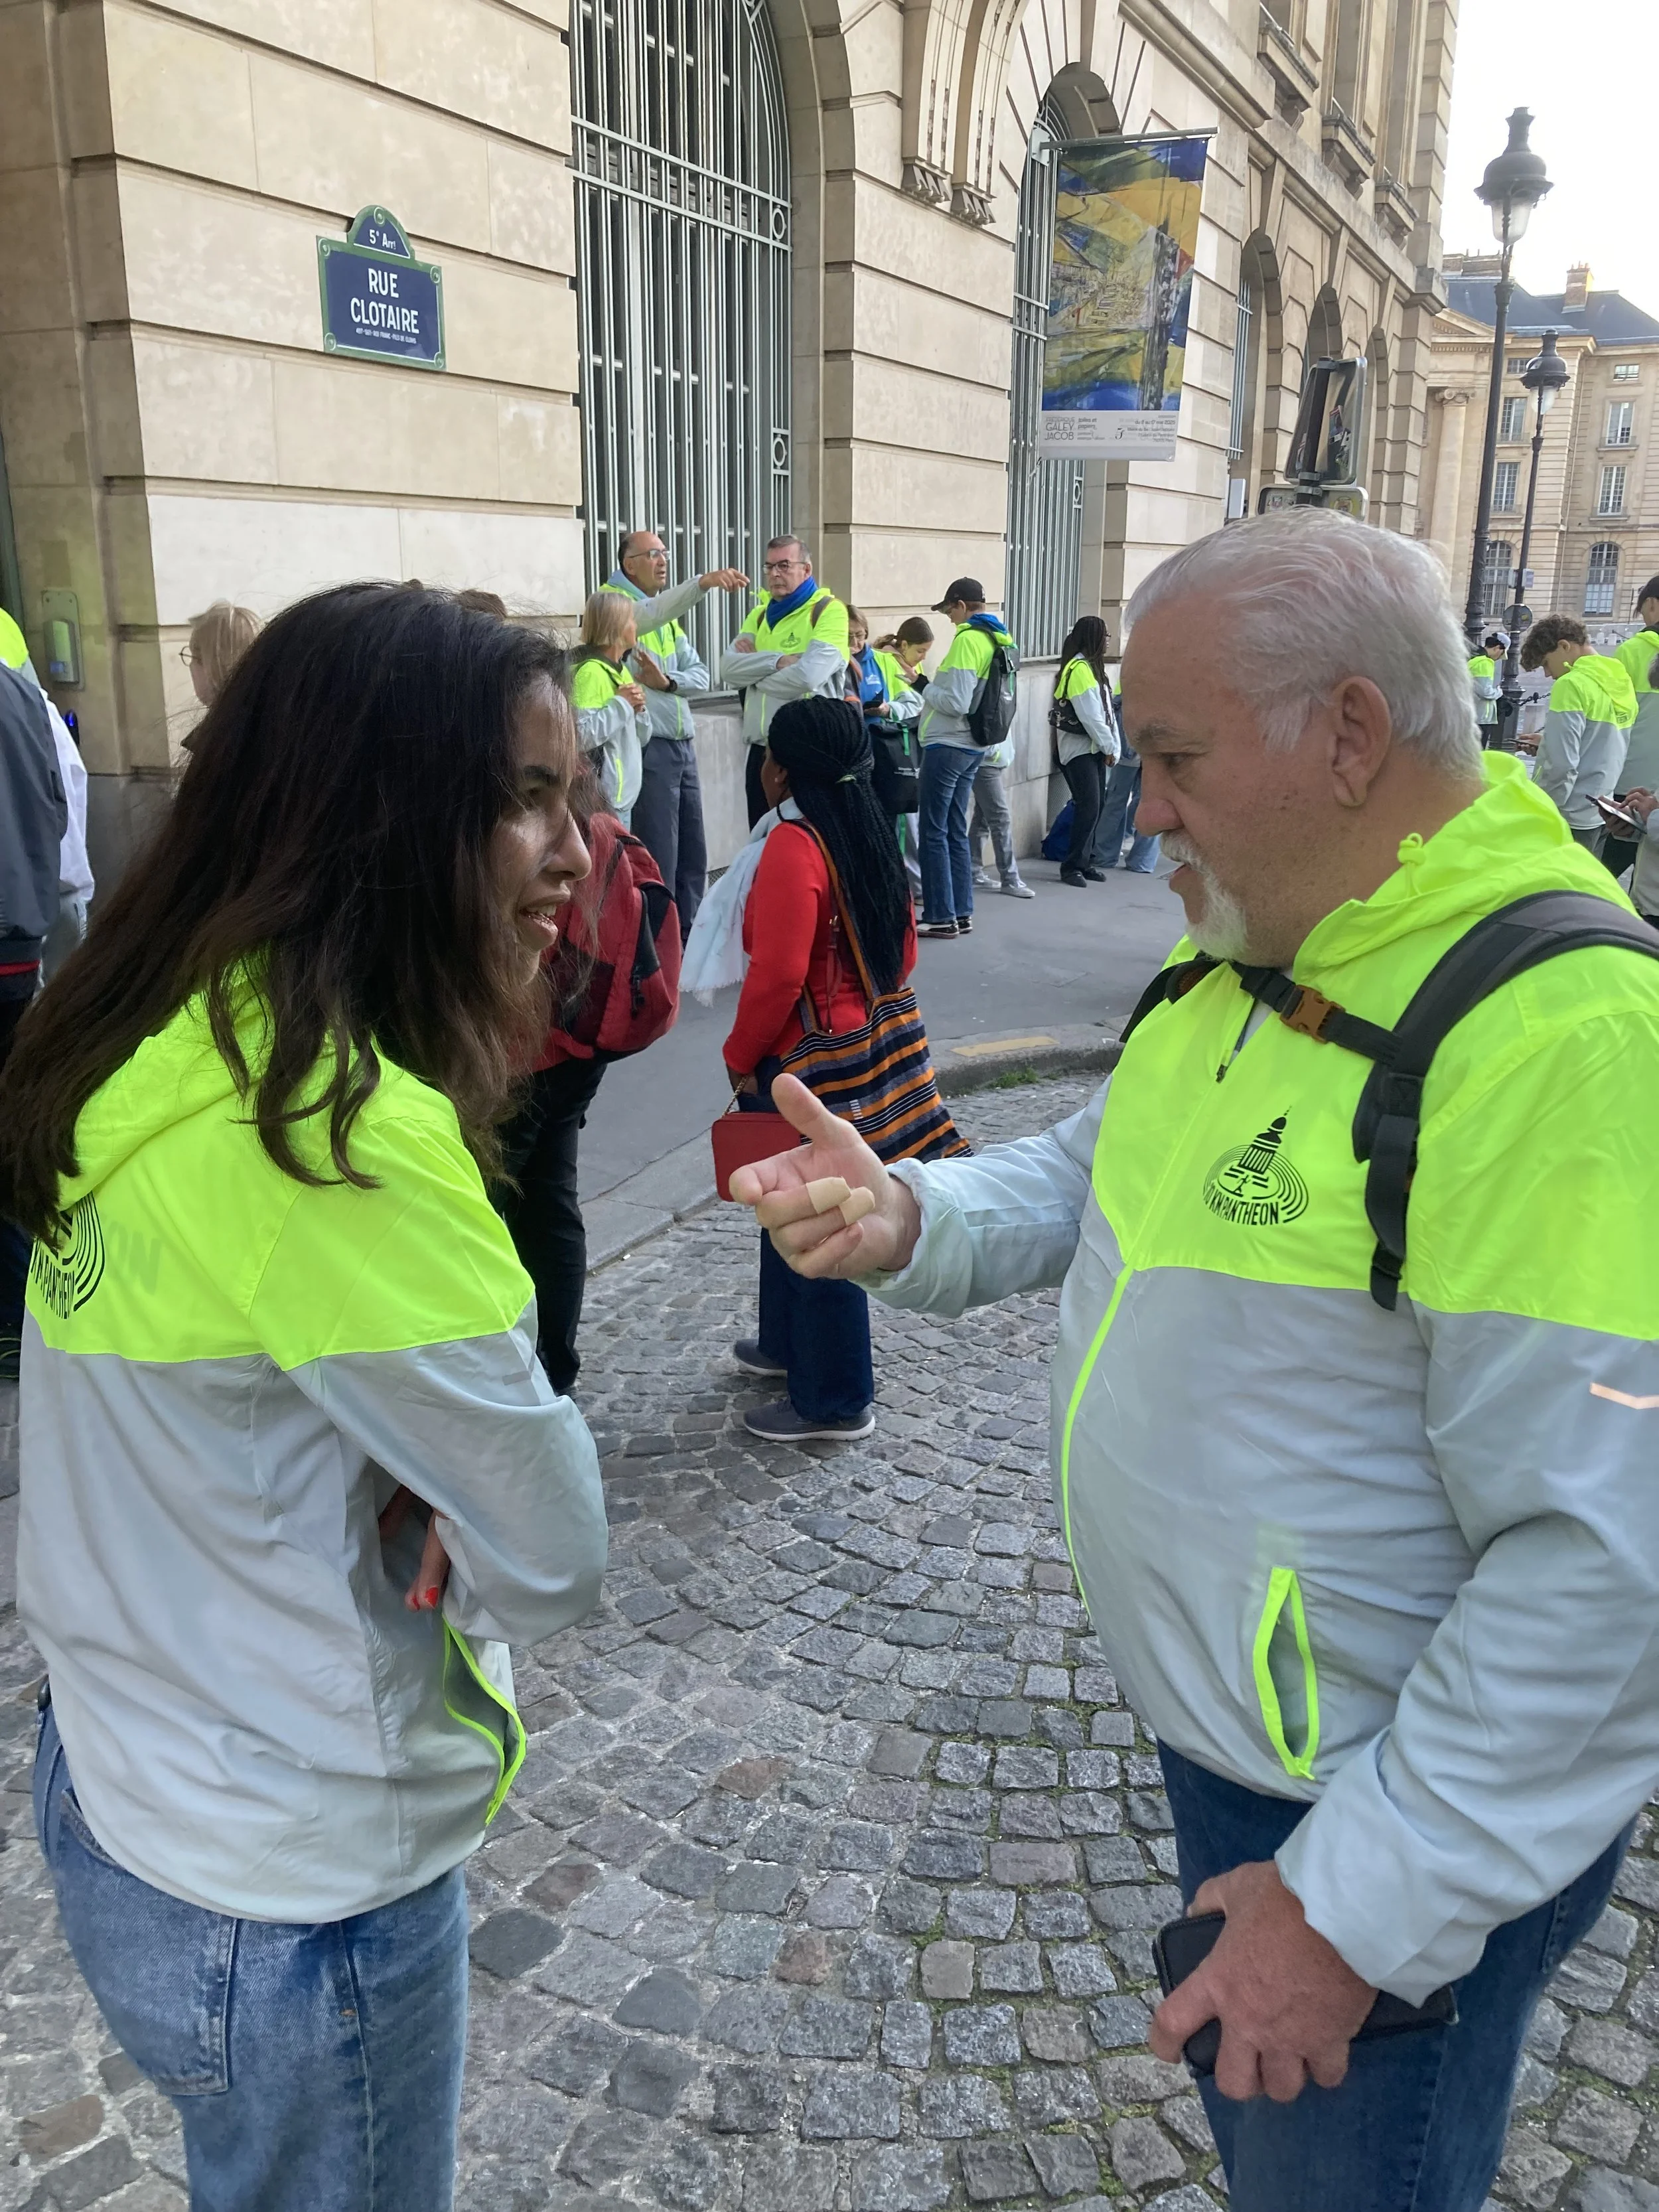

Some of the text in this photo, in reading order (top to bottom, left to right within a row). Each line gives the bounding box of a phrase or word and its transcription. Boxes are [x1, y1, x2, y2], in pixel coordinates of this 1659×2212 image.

[368, 267, 399, 298] RUE
[350, 297, 419, 334] CLOTAIRE
[1045, 431, 1074, 441] JACOB
[1046, 422, 1074, 431] GALEY
[1220, 1197, 1279, 1225] PANTHEON
